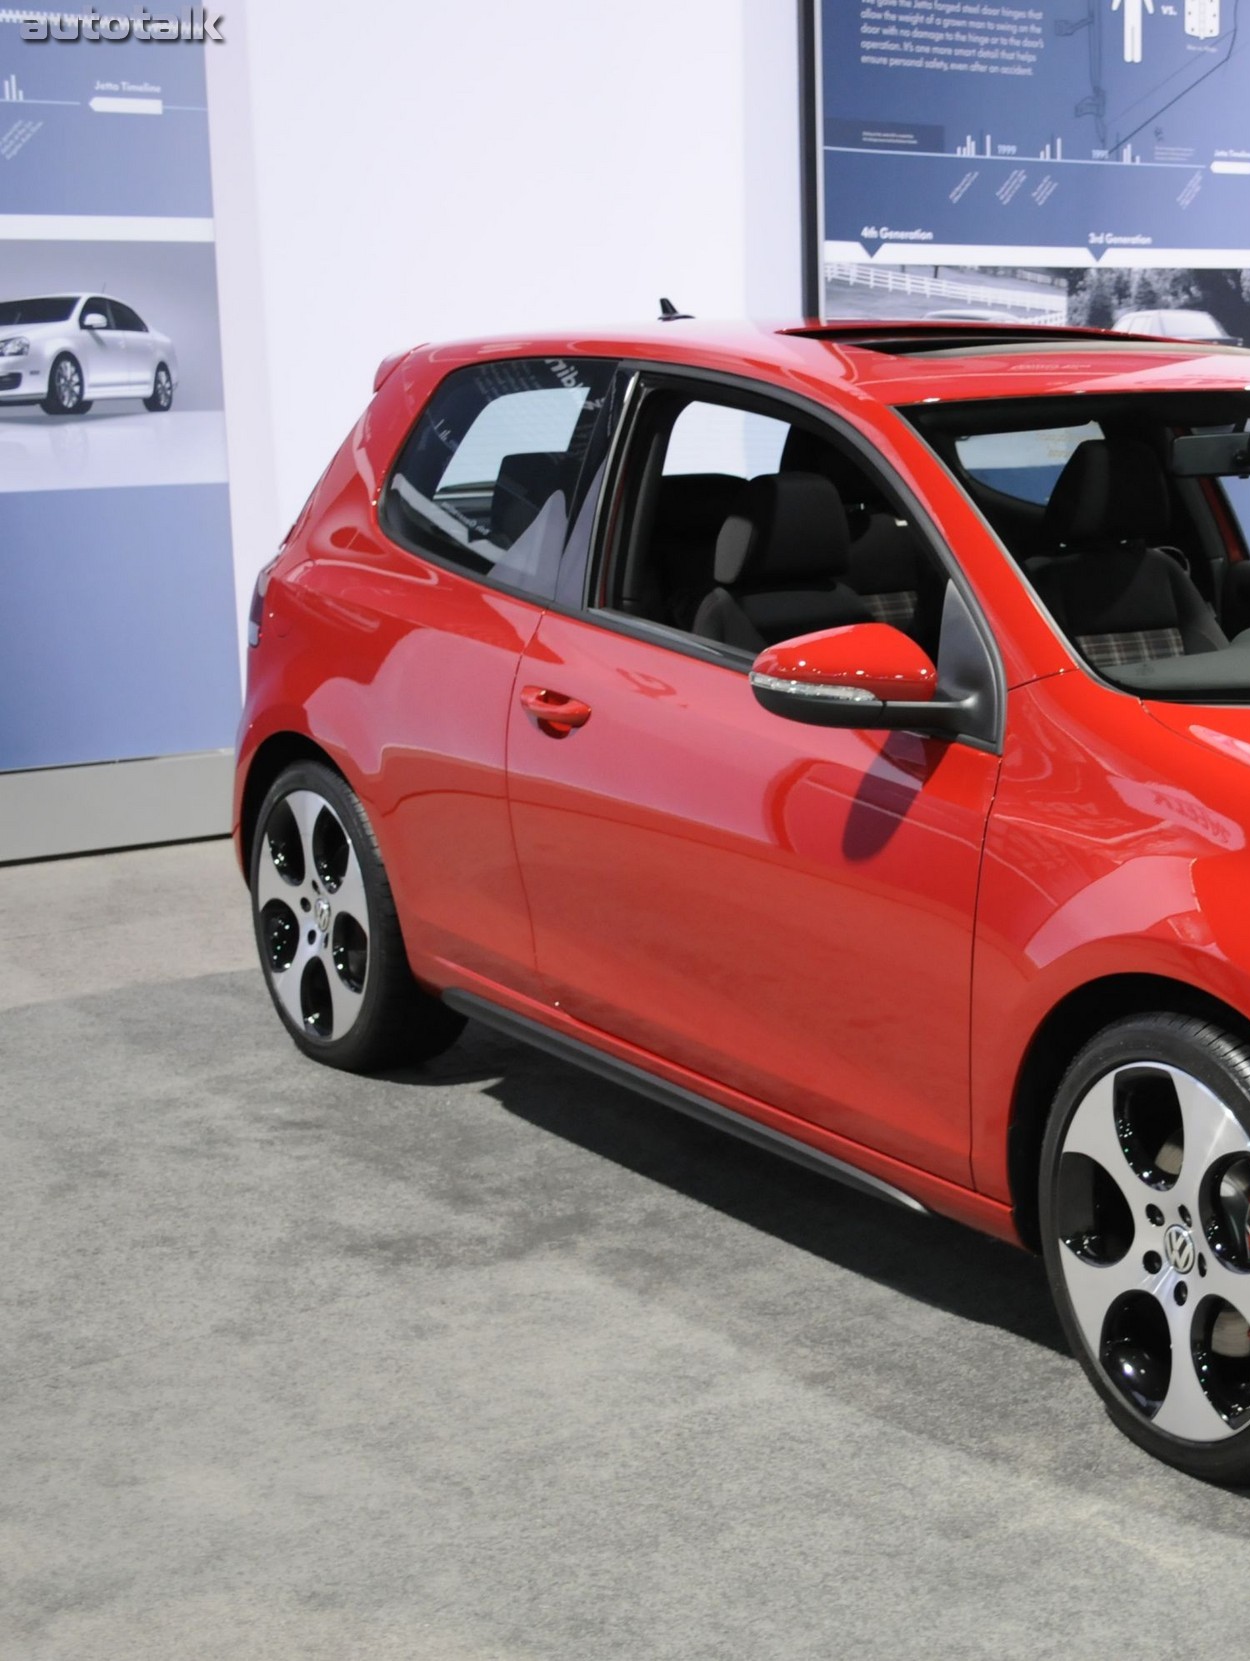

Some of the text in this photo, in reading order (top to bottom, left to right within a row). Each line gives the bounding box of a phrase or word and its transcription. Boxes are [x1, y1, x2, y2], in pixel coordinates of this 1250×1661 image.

[933, 0, 961, 14] forged
[961, 4, 980, 14] steel
[981, 5, 1000, 16] door
[1000, 6, 1027, 20] hinges
[1027, 8, 1043, 20] that
[1161, 5, 1177, 16] vs.
[860, 8, 882, 19] allow
[883, 10, 896, 21] the
[897, 12, 925, 26] weight
[942, 18, 967, 29] grown
[968, 20, 986, 29] man
[995, 22, 1017, 35] swing
[1029, 23, 1042, 34] the
[860, 22, 880, 34] door
[881, 25, 898, 36] with
[911, 27, 944, 42] damage
[953, 31, 967, 42] the
[967, 32, 989, 46] hinge
[1008, 35, 1021, 47] the
[914, 45, 930, 53] one
[931, 46, 953, 55] more
[953, 48, 976, 57] smart
[977, 47, 999, 59] detail
[1000, 49, 1015, 60] that
[1015, 50, 1037, 63] helps
[860, 55, 888, 65] ensure
[888, 57, 924, 68] personal
[949, 63, 968, 71] even
[969, 60, 988, 73] after
[94, 79, 162, 94] Jetta Timeline
[860, 226, 934, 241] 4th Generation
[1088, 232, 1153, 245] 3rd Generation
